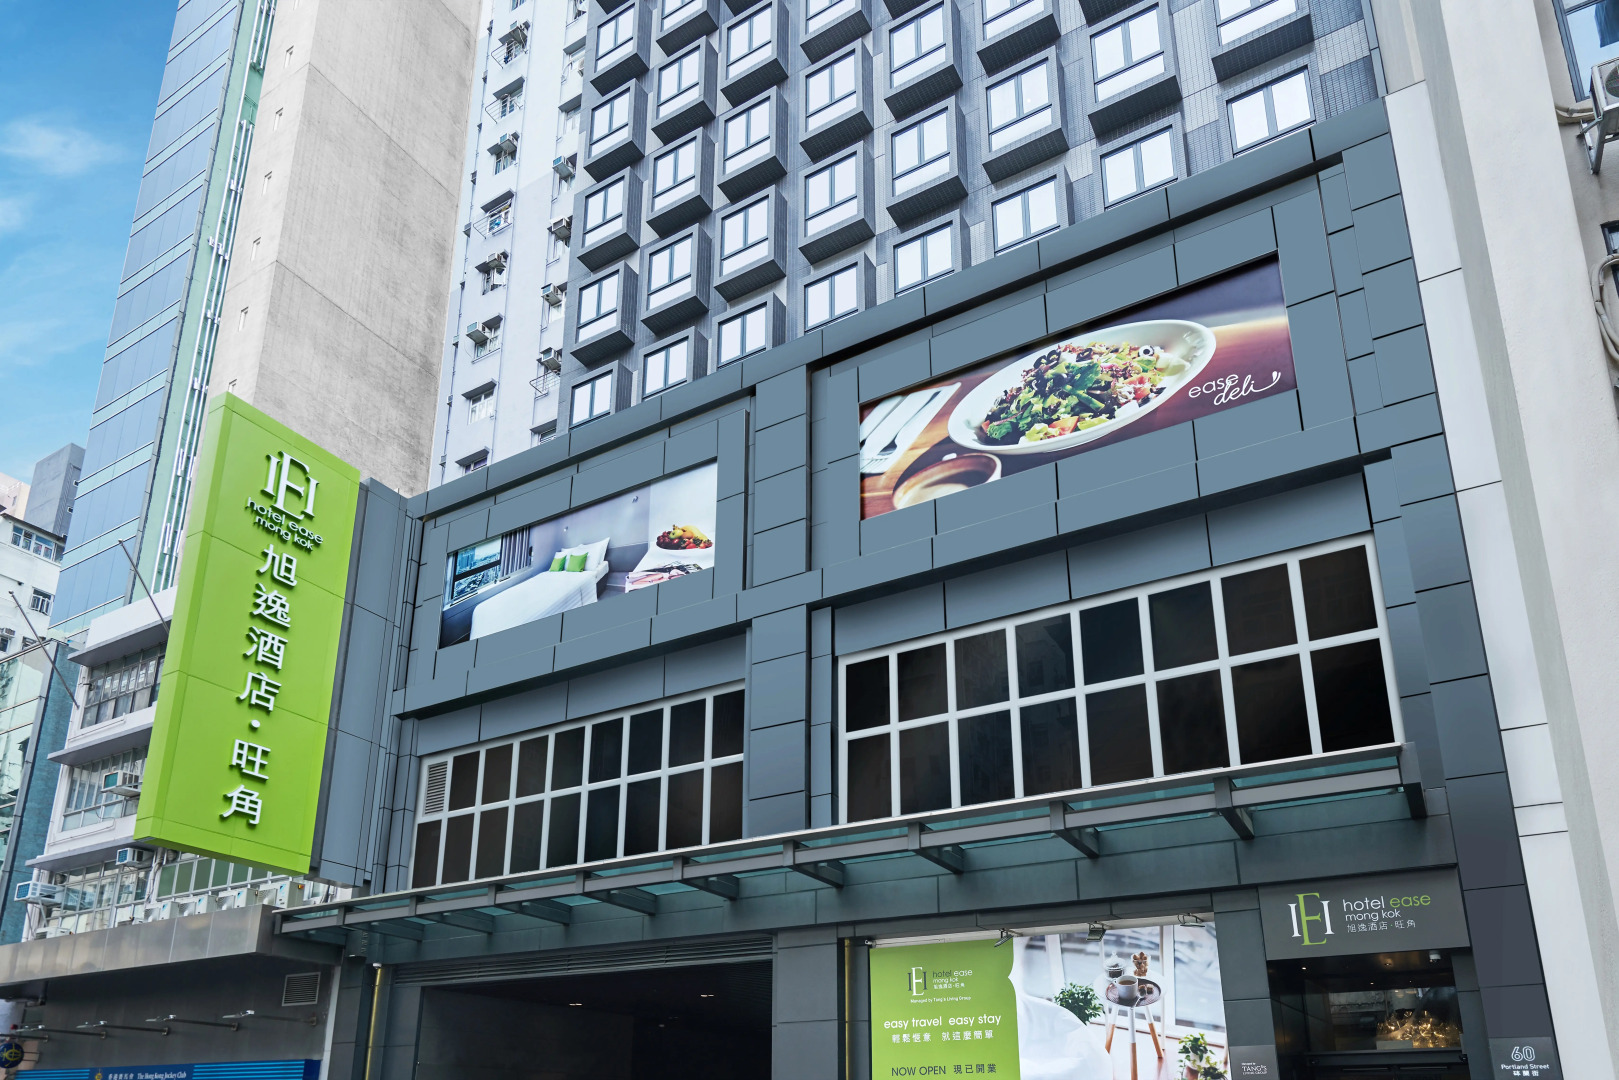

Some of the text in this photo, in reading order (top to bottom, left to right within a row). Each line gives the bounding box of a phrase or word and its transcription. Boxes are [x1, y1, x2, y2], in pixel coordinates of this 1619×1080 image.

[1188, 374, 1239, 398] ease
[1213, 371, 1281, 406] deli
[247, 497, 324, 544] hotel ease
[255, 515, 314, 551] mong kok
[1342, 895, 1431, 911] hotel ease
[1345, 908, 1402, 922] mong kok
[883, 1014, 1002, 1030] easy travel easy stay
[1511, 1045, 1536, 1062] 60
[891, 1063, 997, 1077] NOW OPEN 現已開業
